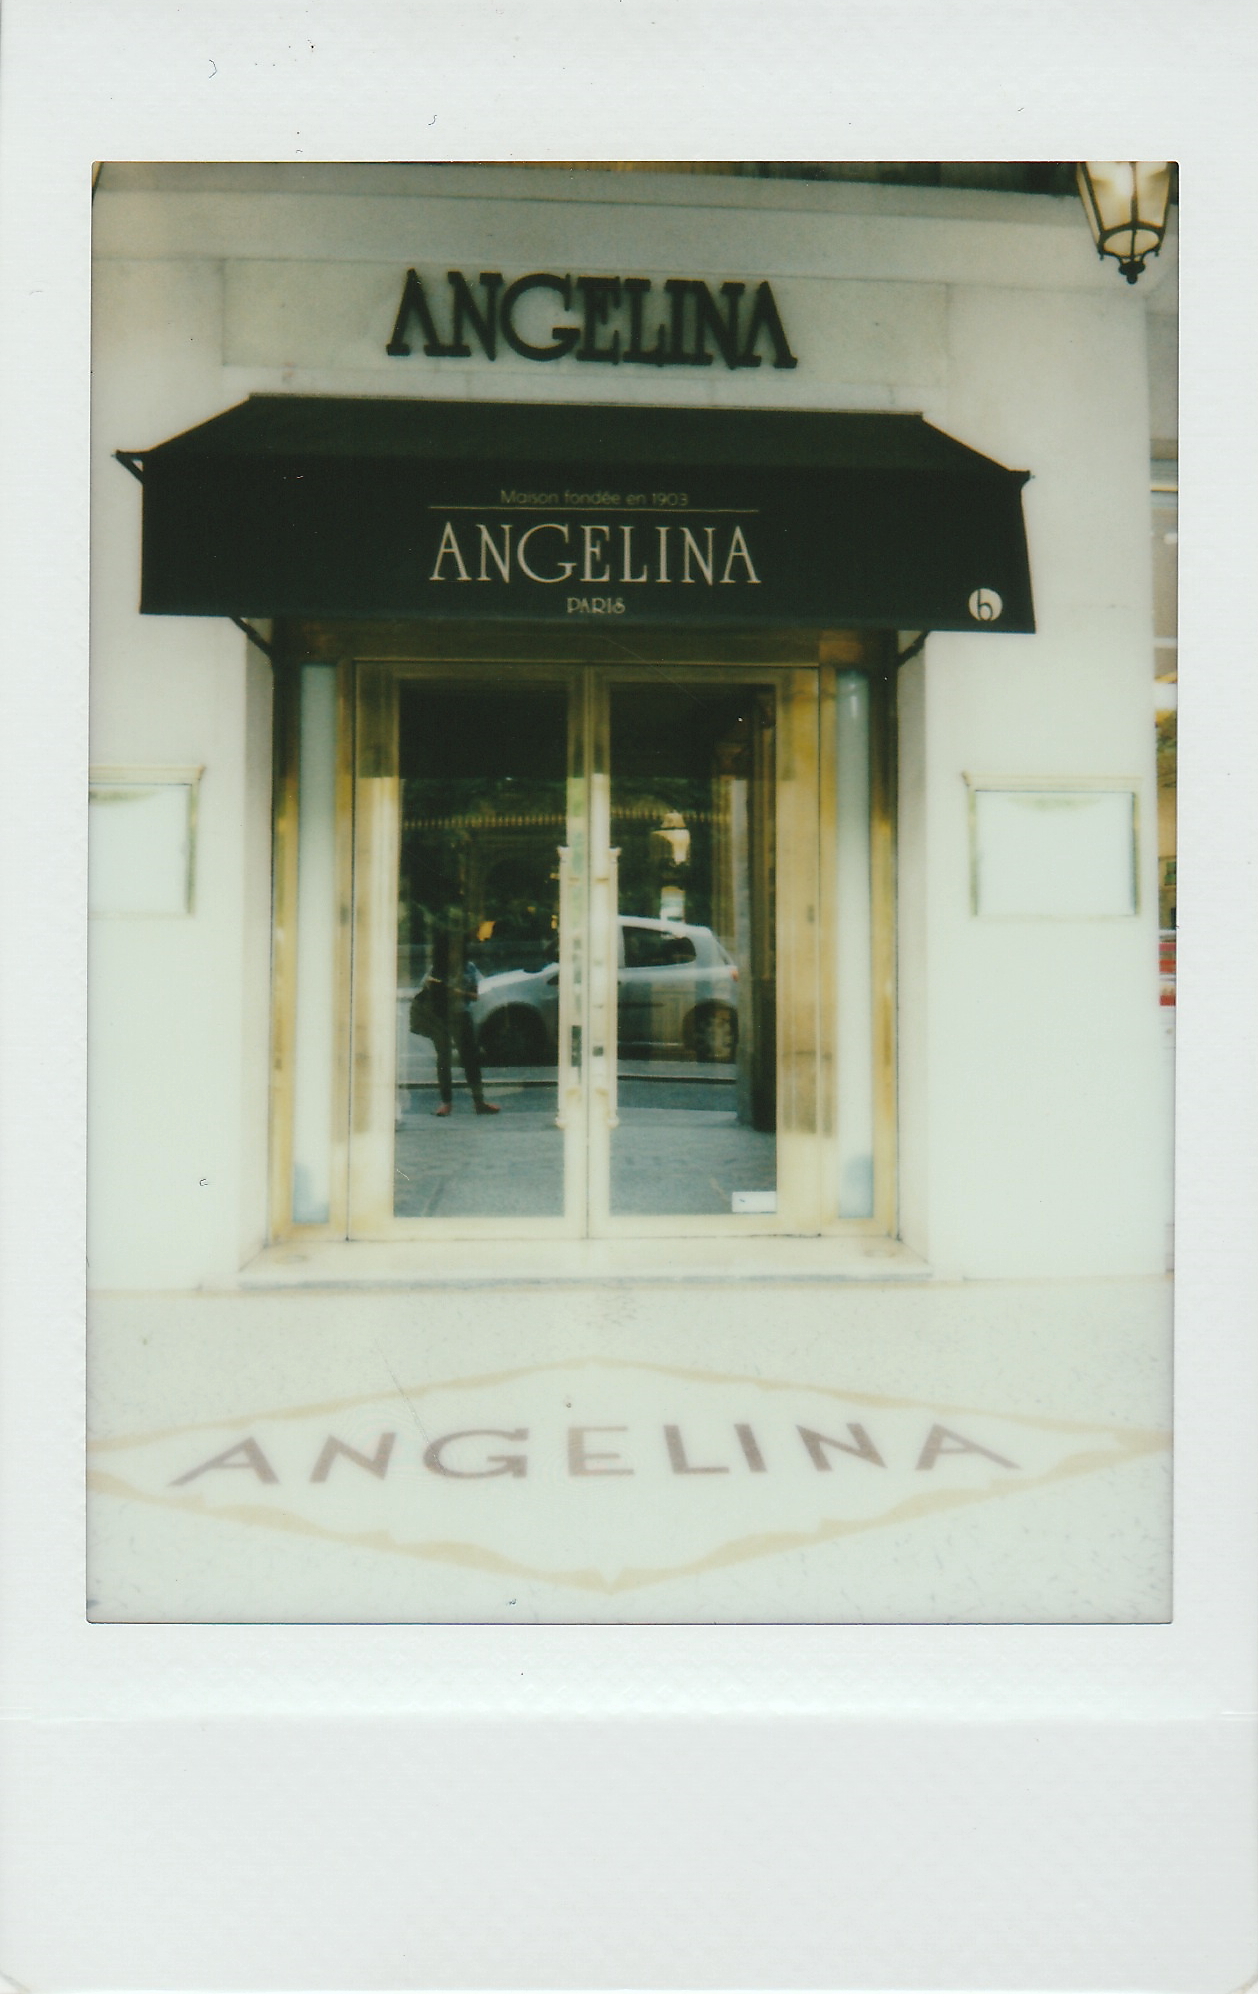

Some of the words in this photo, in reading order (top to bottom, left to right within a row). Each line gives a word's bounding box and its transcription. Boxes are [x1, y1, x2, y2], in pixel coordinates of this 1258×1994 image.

[387, 268, 798, 368] ANGELINA
[500, 490, 558, 505] Maison
[564, 490, 620, 505] fondée
[626, 494, 647, 506] en
[651, 492, 689, 507] 1903
[430, 522, 762, 586] ANGELINA
[566, 597, 626, 615] PARIS
[169, 1422, 1021, 1486] ANGELINA
